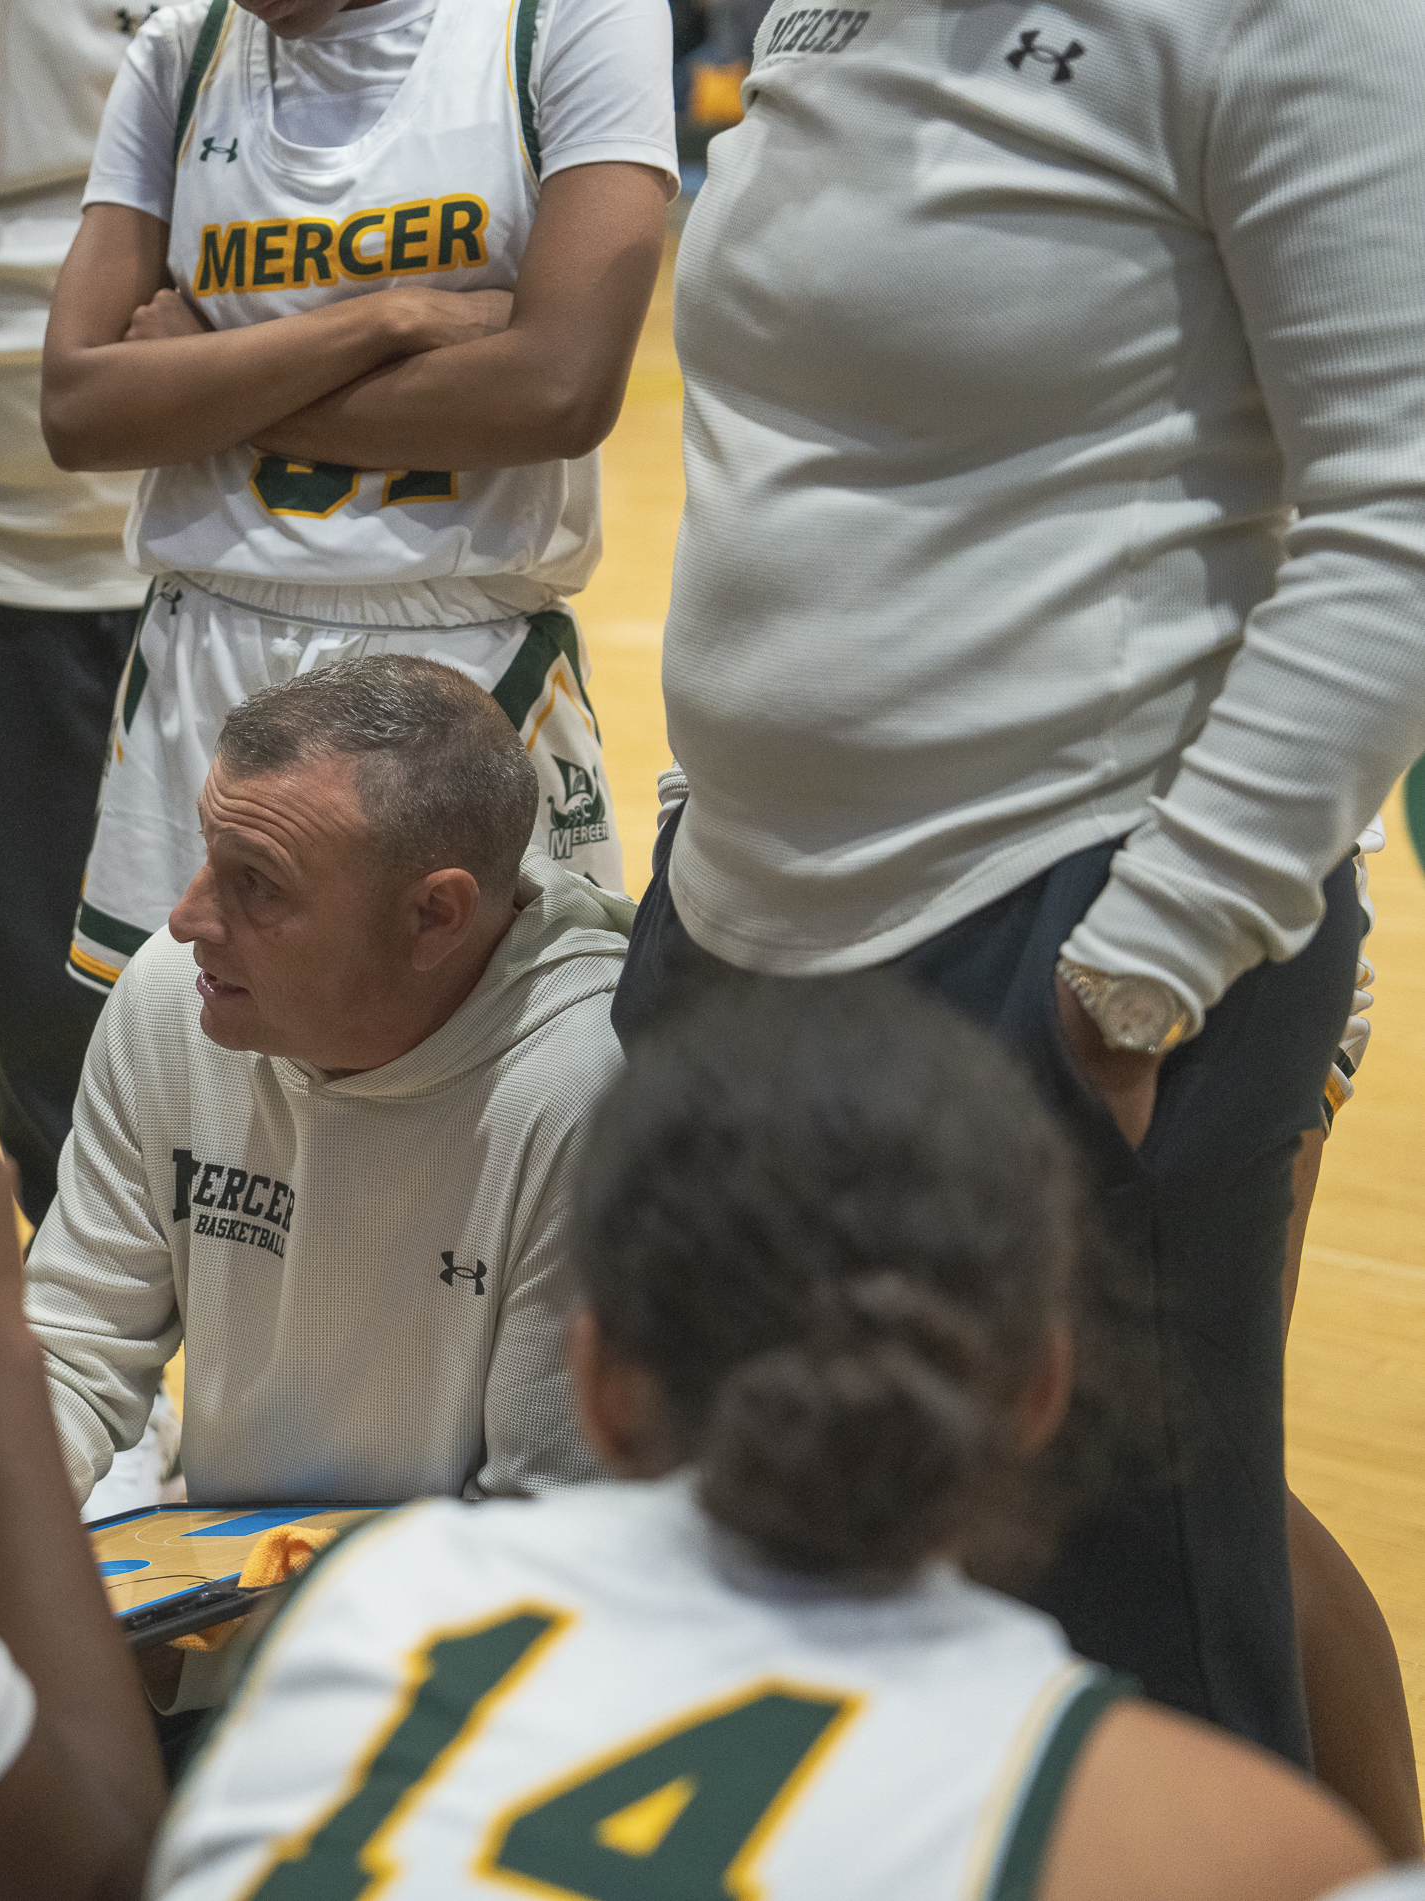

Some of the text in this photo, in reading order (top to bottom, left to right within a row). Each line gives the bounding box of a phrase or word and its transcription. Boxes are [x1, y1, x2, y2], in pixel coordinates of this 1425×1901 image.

[193, 193, 488, 298] MERCER
[549, 820, 610, 860] MERCER
[194, 1214, 285, 1259] BASKETBALL
[238, 1599, 871, 1901] 14
